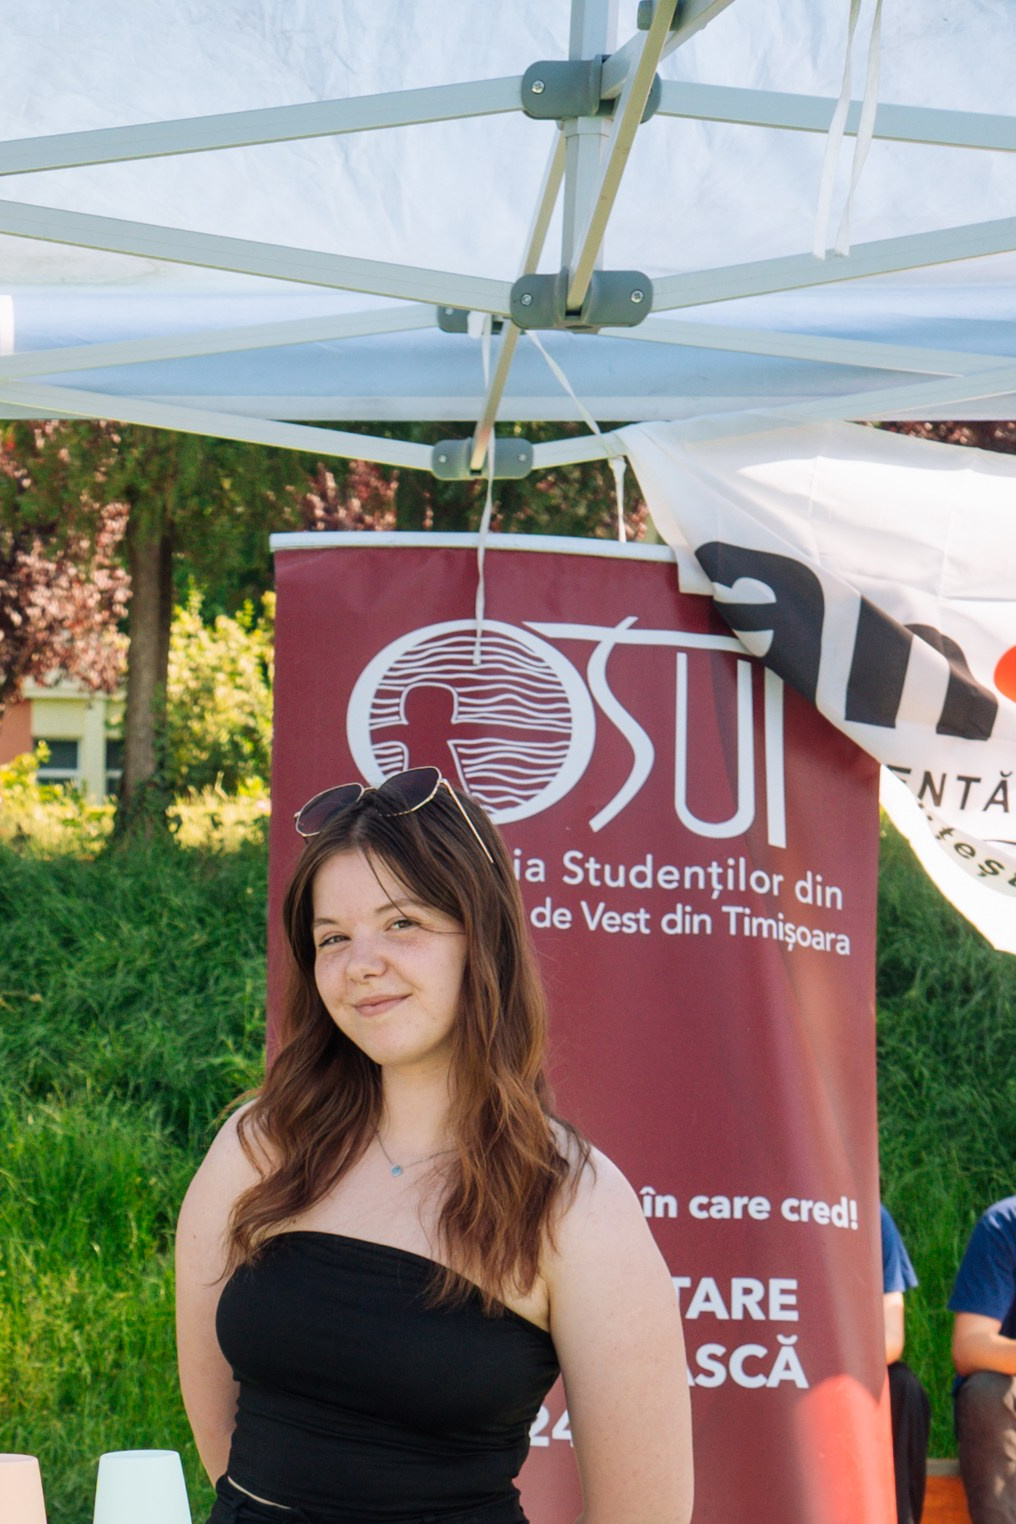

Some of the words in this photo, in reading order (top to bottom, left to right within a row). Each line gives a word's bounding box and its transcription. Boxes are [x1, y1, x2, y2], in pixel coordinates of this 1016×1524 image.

[562, 849, 784, 900] Studenților
[794, 869, 844, 911] din
[530, 896, 573, 929] de
[580, 900, 651, 935] Vest
[660, 902, 713, 936] din
[721, 905, 852, 956] Timișoara
[639, 1186, 678, 1218] în
[688, 1194, 772, 1221] care
[780, 1196, 859, 1231] cred!
